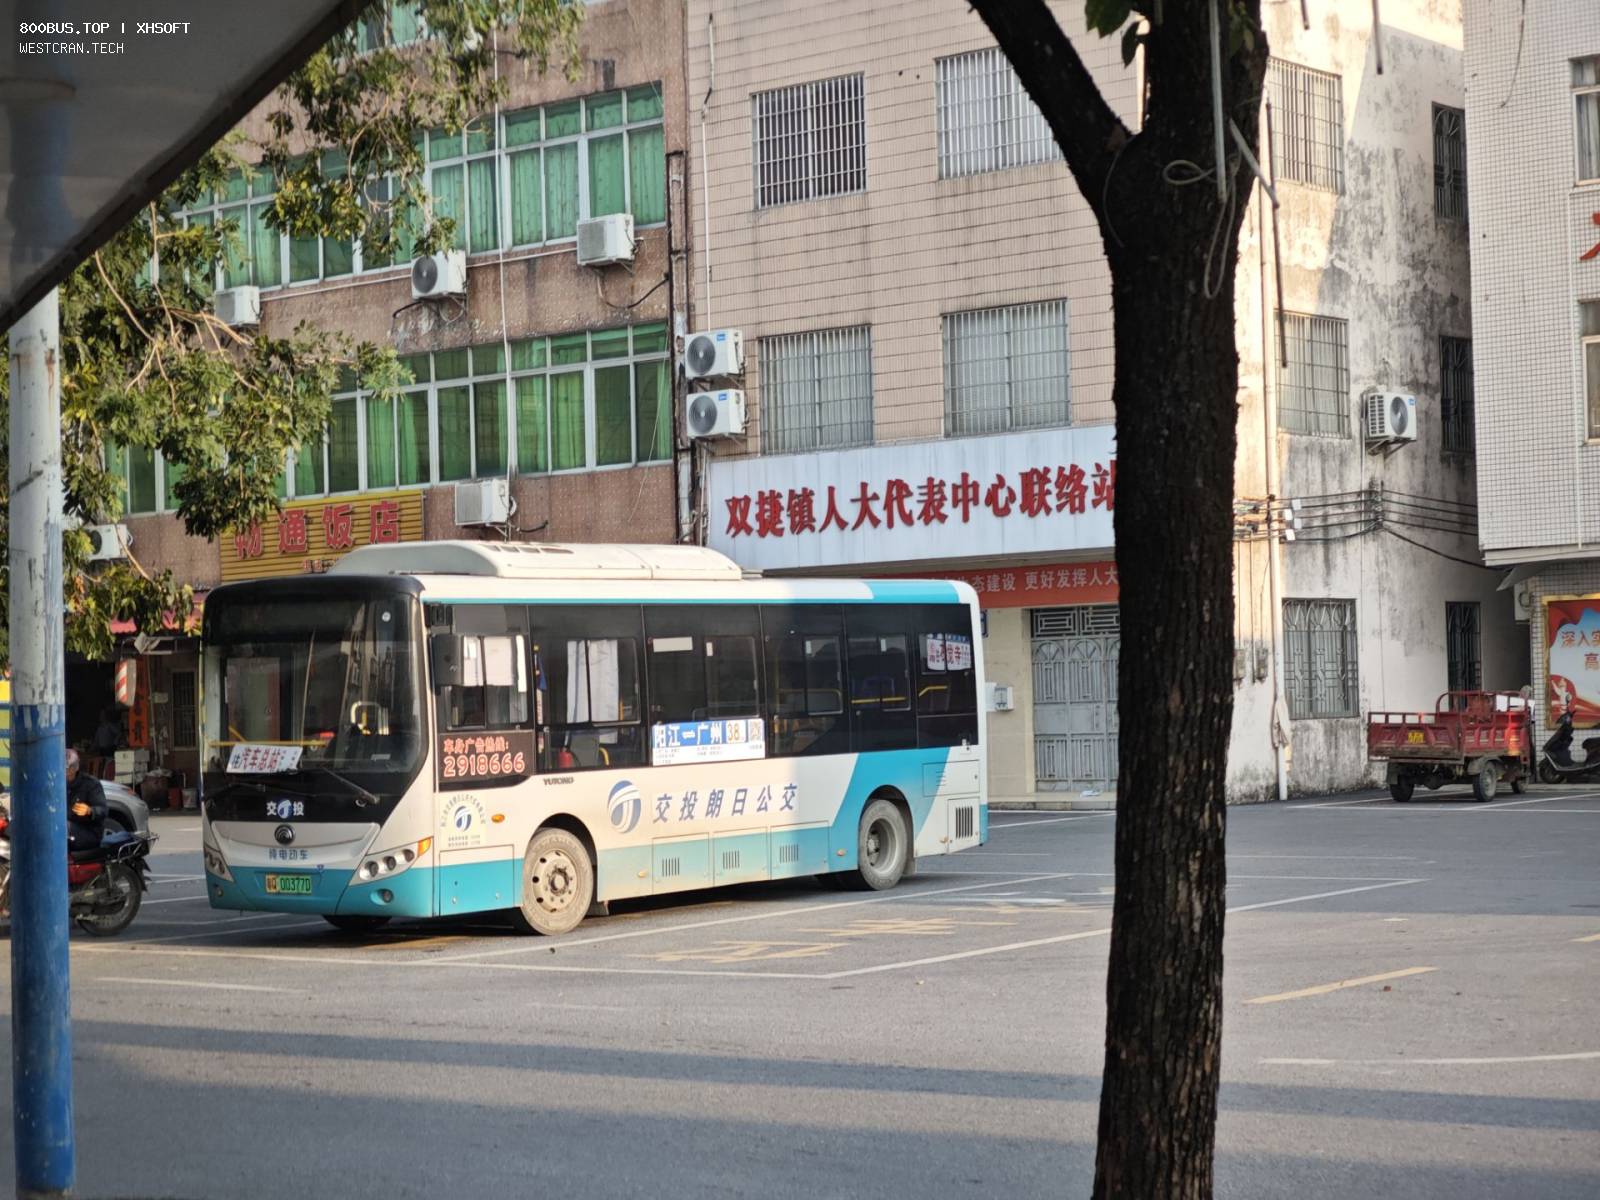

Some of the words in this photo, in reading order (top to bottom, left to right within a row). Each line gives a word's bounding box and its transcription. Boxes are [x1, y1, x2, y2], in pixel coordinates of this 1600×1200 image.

[724, 459, 1118, 538] 双捷镇人大代表中心联络站
[1024, 566, 1119, 591] 更好发挥人大
[443, 752, 525, 777] 2918666
[653, 783, 798, 824] 交投朗日公交
